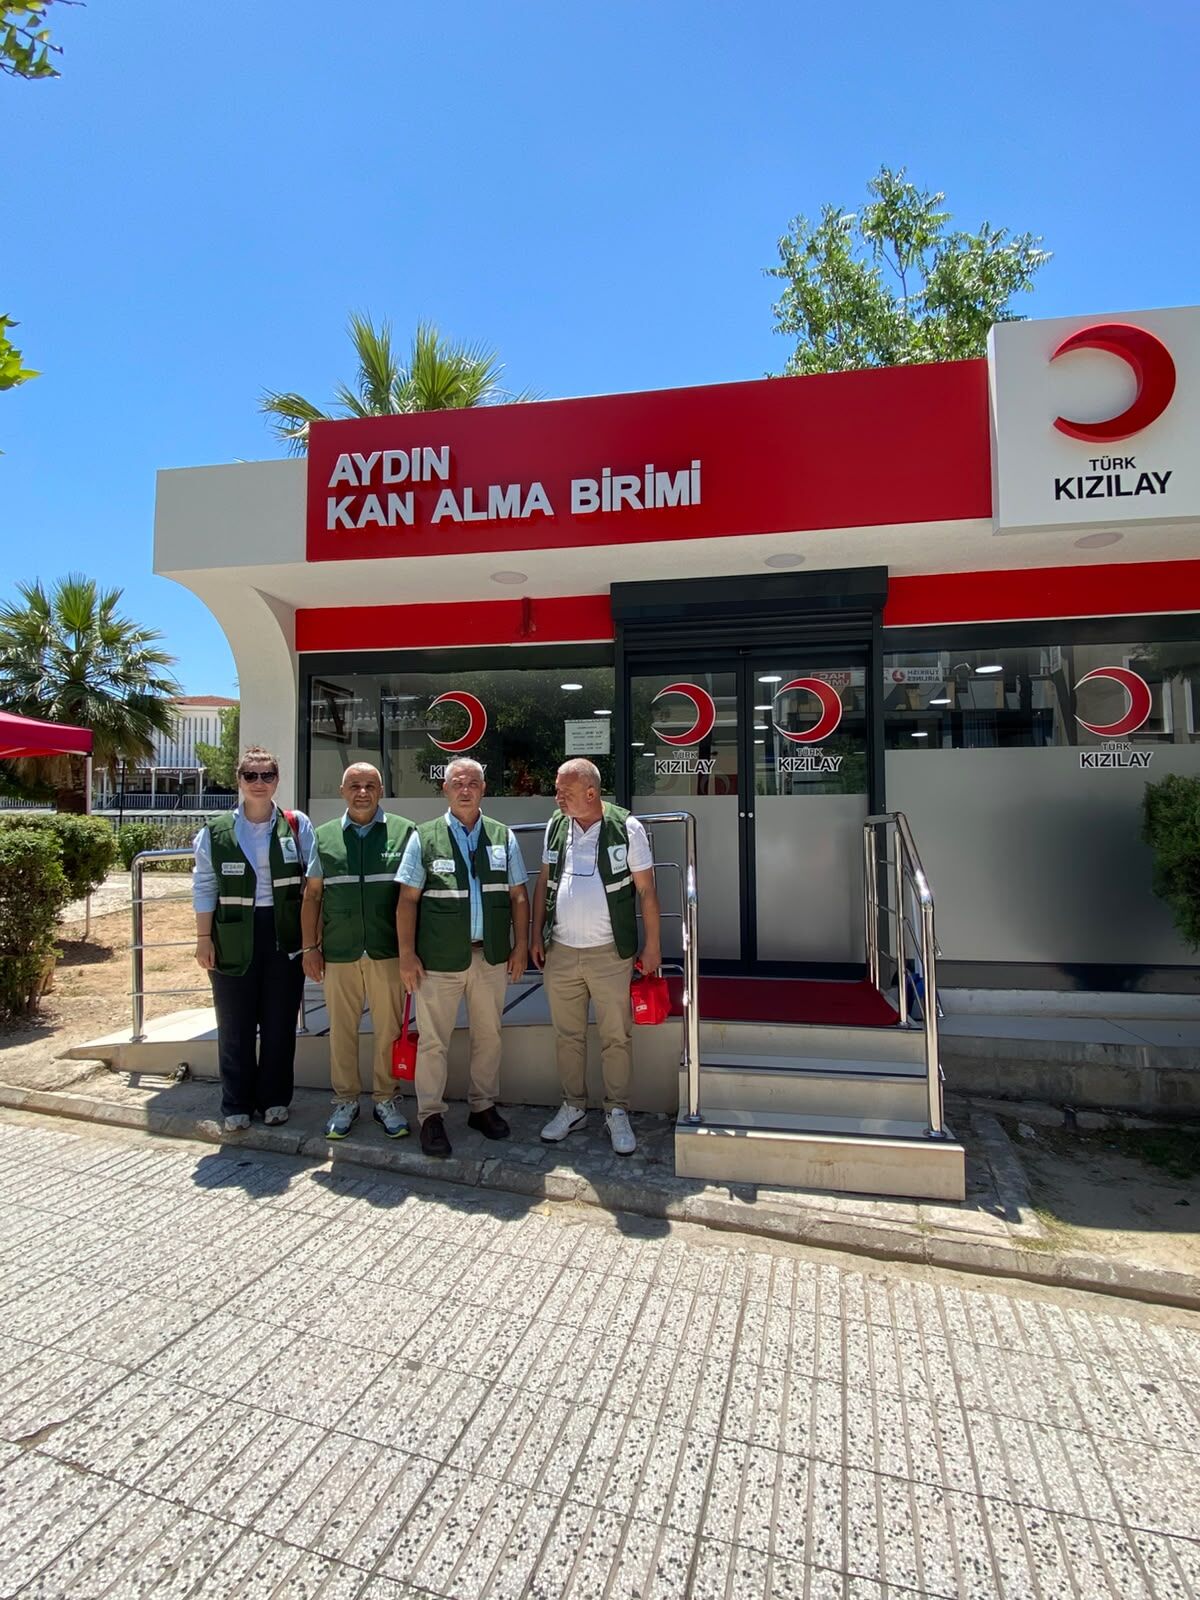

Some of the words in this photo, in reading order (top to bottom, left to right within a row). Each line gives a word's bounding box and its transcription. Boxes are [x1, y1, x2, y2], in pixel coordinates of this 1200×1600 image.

[327, 445, 451, 488] AYDIN
[1089, 455, 1136, 471] TÜRK
[1054, 470, 1173, 501] KIZILAY
[326, 491, 415, 531] KAN
[431, 481, 555, 524] ALMA
[570, 459, 702, 515] BİRİMİ
[672, 749, 699, 760] TÜRK
[796, 747, 824, 758] TÜRK
[1102, 741, 1130, 751] TÜRK
[654, 759, 716, 776] KIZILAY
[777, 756, 843, 773] KIZILAY
[1079, 751, 1154, 769] KIZILAY
